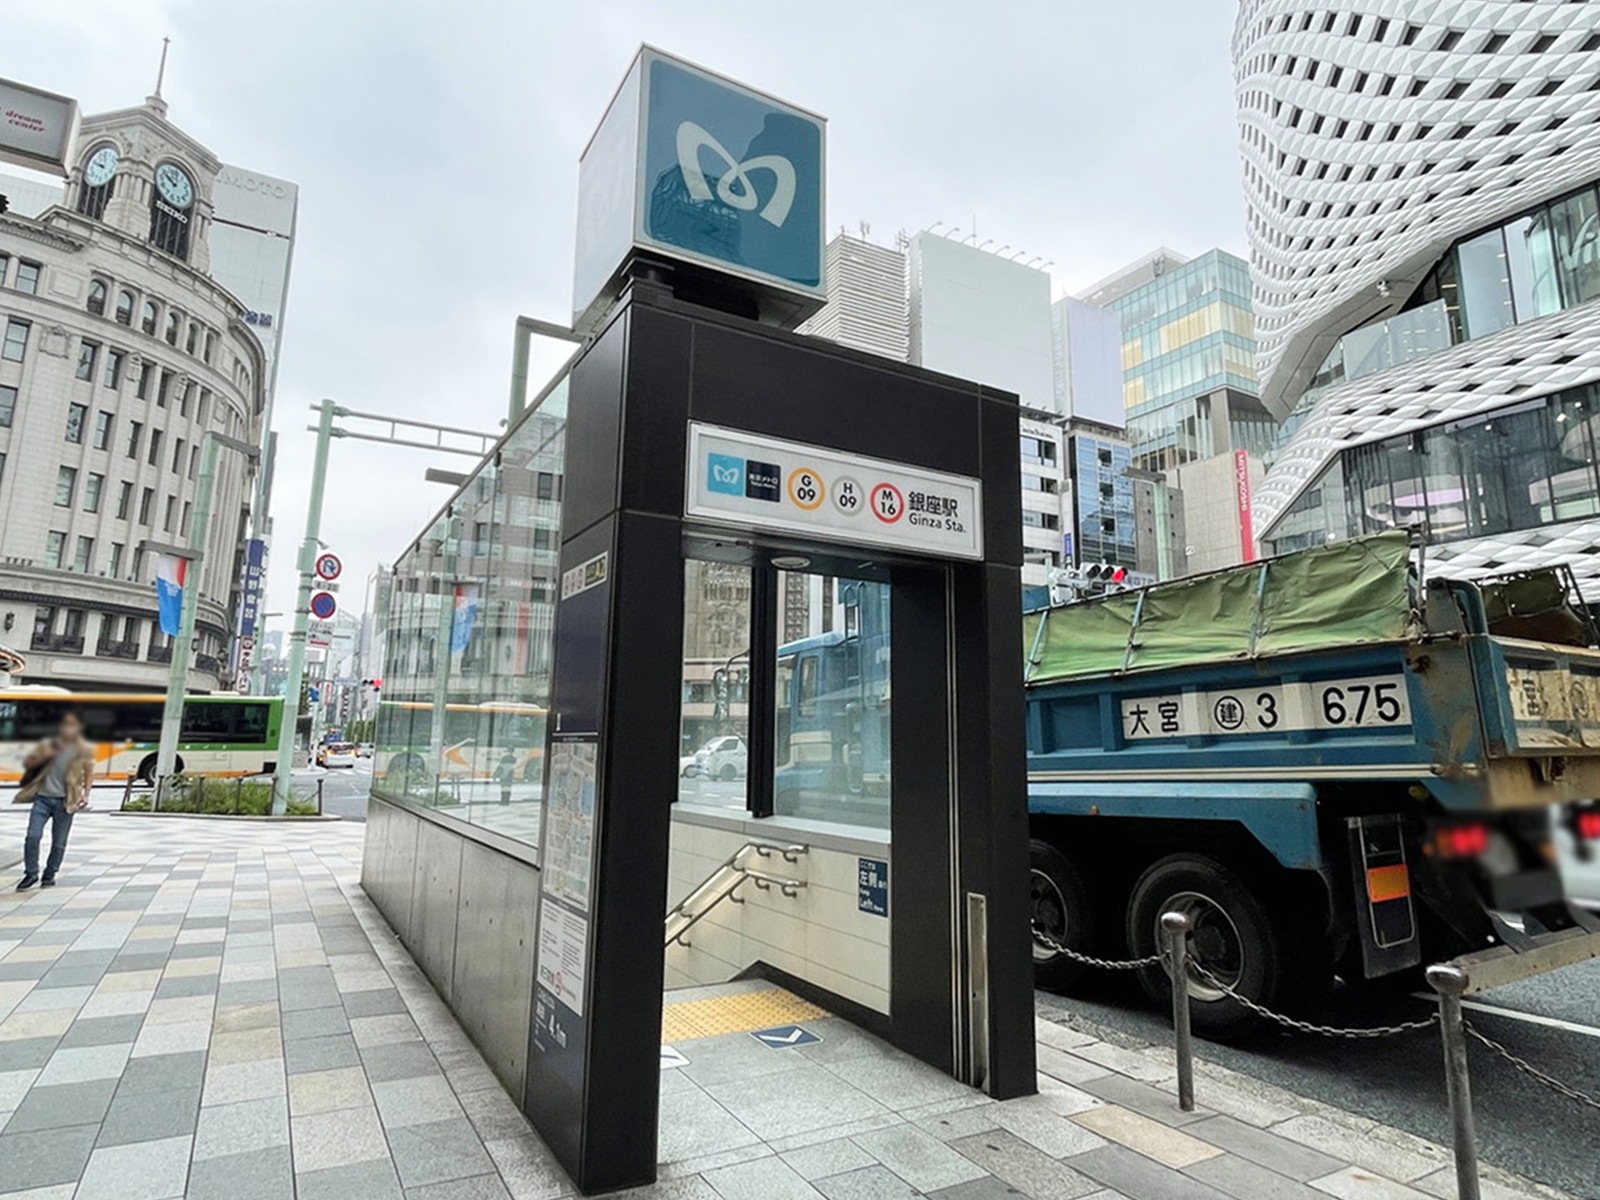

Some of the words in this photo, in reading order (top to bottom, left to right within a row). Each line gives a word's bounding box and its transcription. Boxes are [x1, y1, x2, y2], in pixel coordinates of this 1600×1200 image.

[156, 200, 188, 224] SEIKO
[801, 475, 812, 487] G
[843, 483, 853, 494] H
[1238, 454, 1248, 512] MITSUKOSHI
[797, 487, 816, 501] 09
[839, 494, 857, 509] 09
[882, 490, 893, 501] M
[881, 502, 896, 516] 16
[908, 491, 959, 518] 銀座駅
[908, 512, 943, 529] Ginza
[944, 518, 967, 534] Sta.
[1129, 702, 1179, 736] 大宮
[1257, 692, 1278, 729] 3
[1322, 683, 1402, 725] 675
